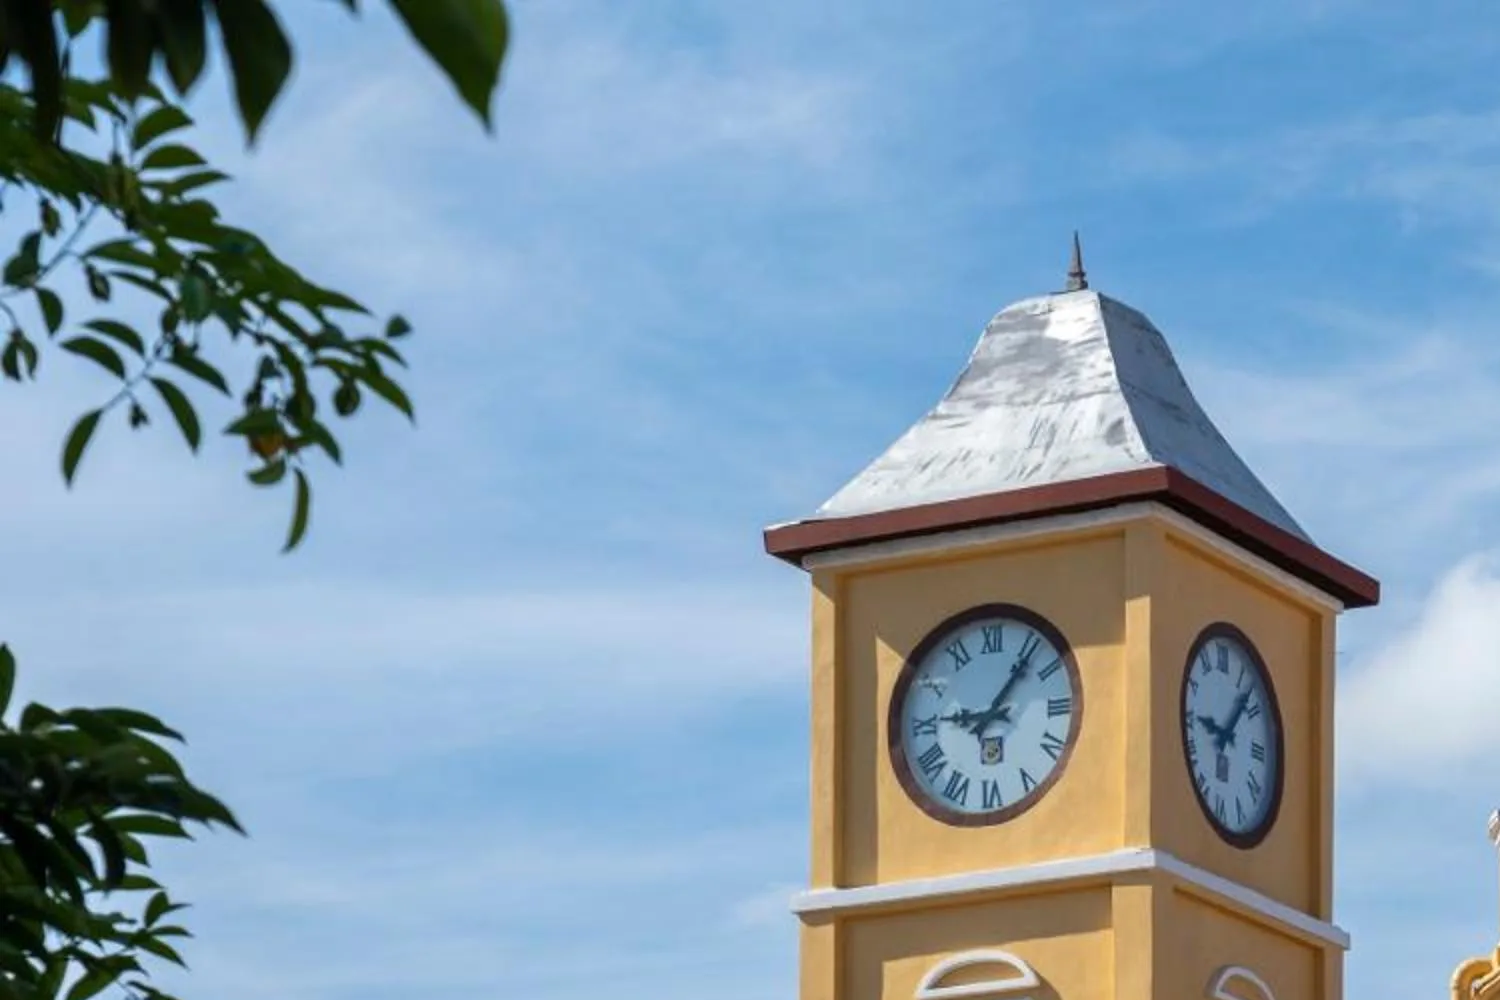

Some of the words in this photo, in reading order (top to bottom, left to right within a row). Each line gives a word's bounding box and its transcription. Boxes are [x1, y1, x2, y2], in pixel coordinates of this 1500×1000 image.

[981, 624, 1003, 654] XII
[944, 639, 972, 671] XI
[1038, 657, 1062, 681] II
[1047, 697, 1073, 718] III
[912, 714, 938, 736] IX
[1039, 731, 1064, 760] IV
[1019, 767, 1037, 792] V
[981, 779, 1003, 808] VI
